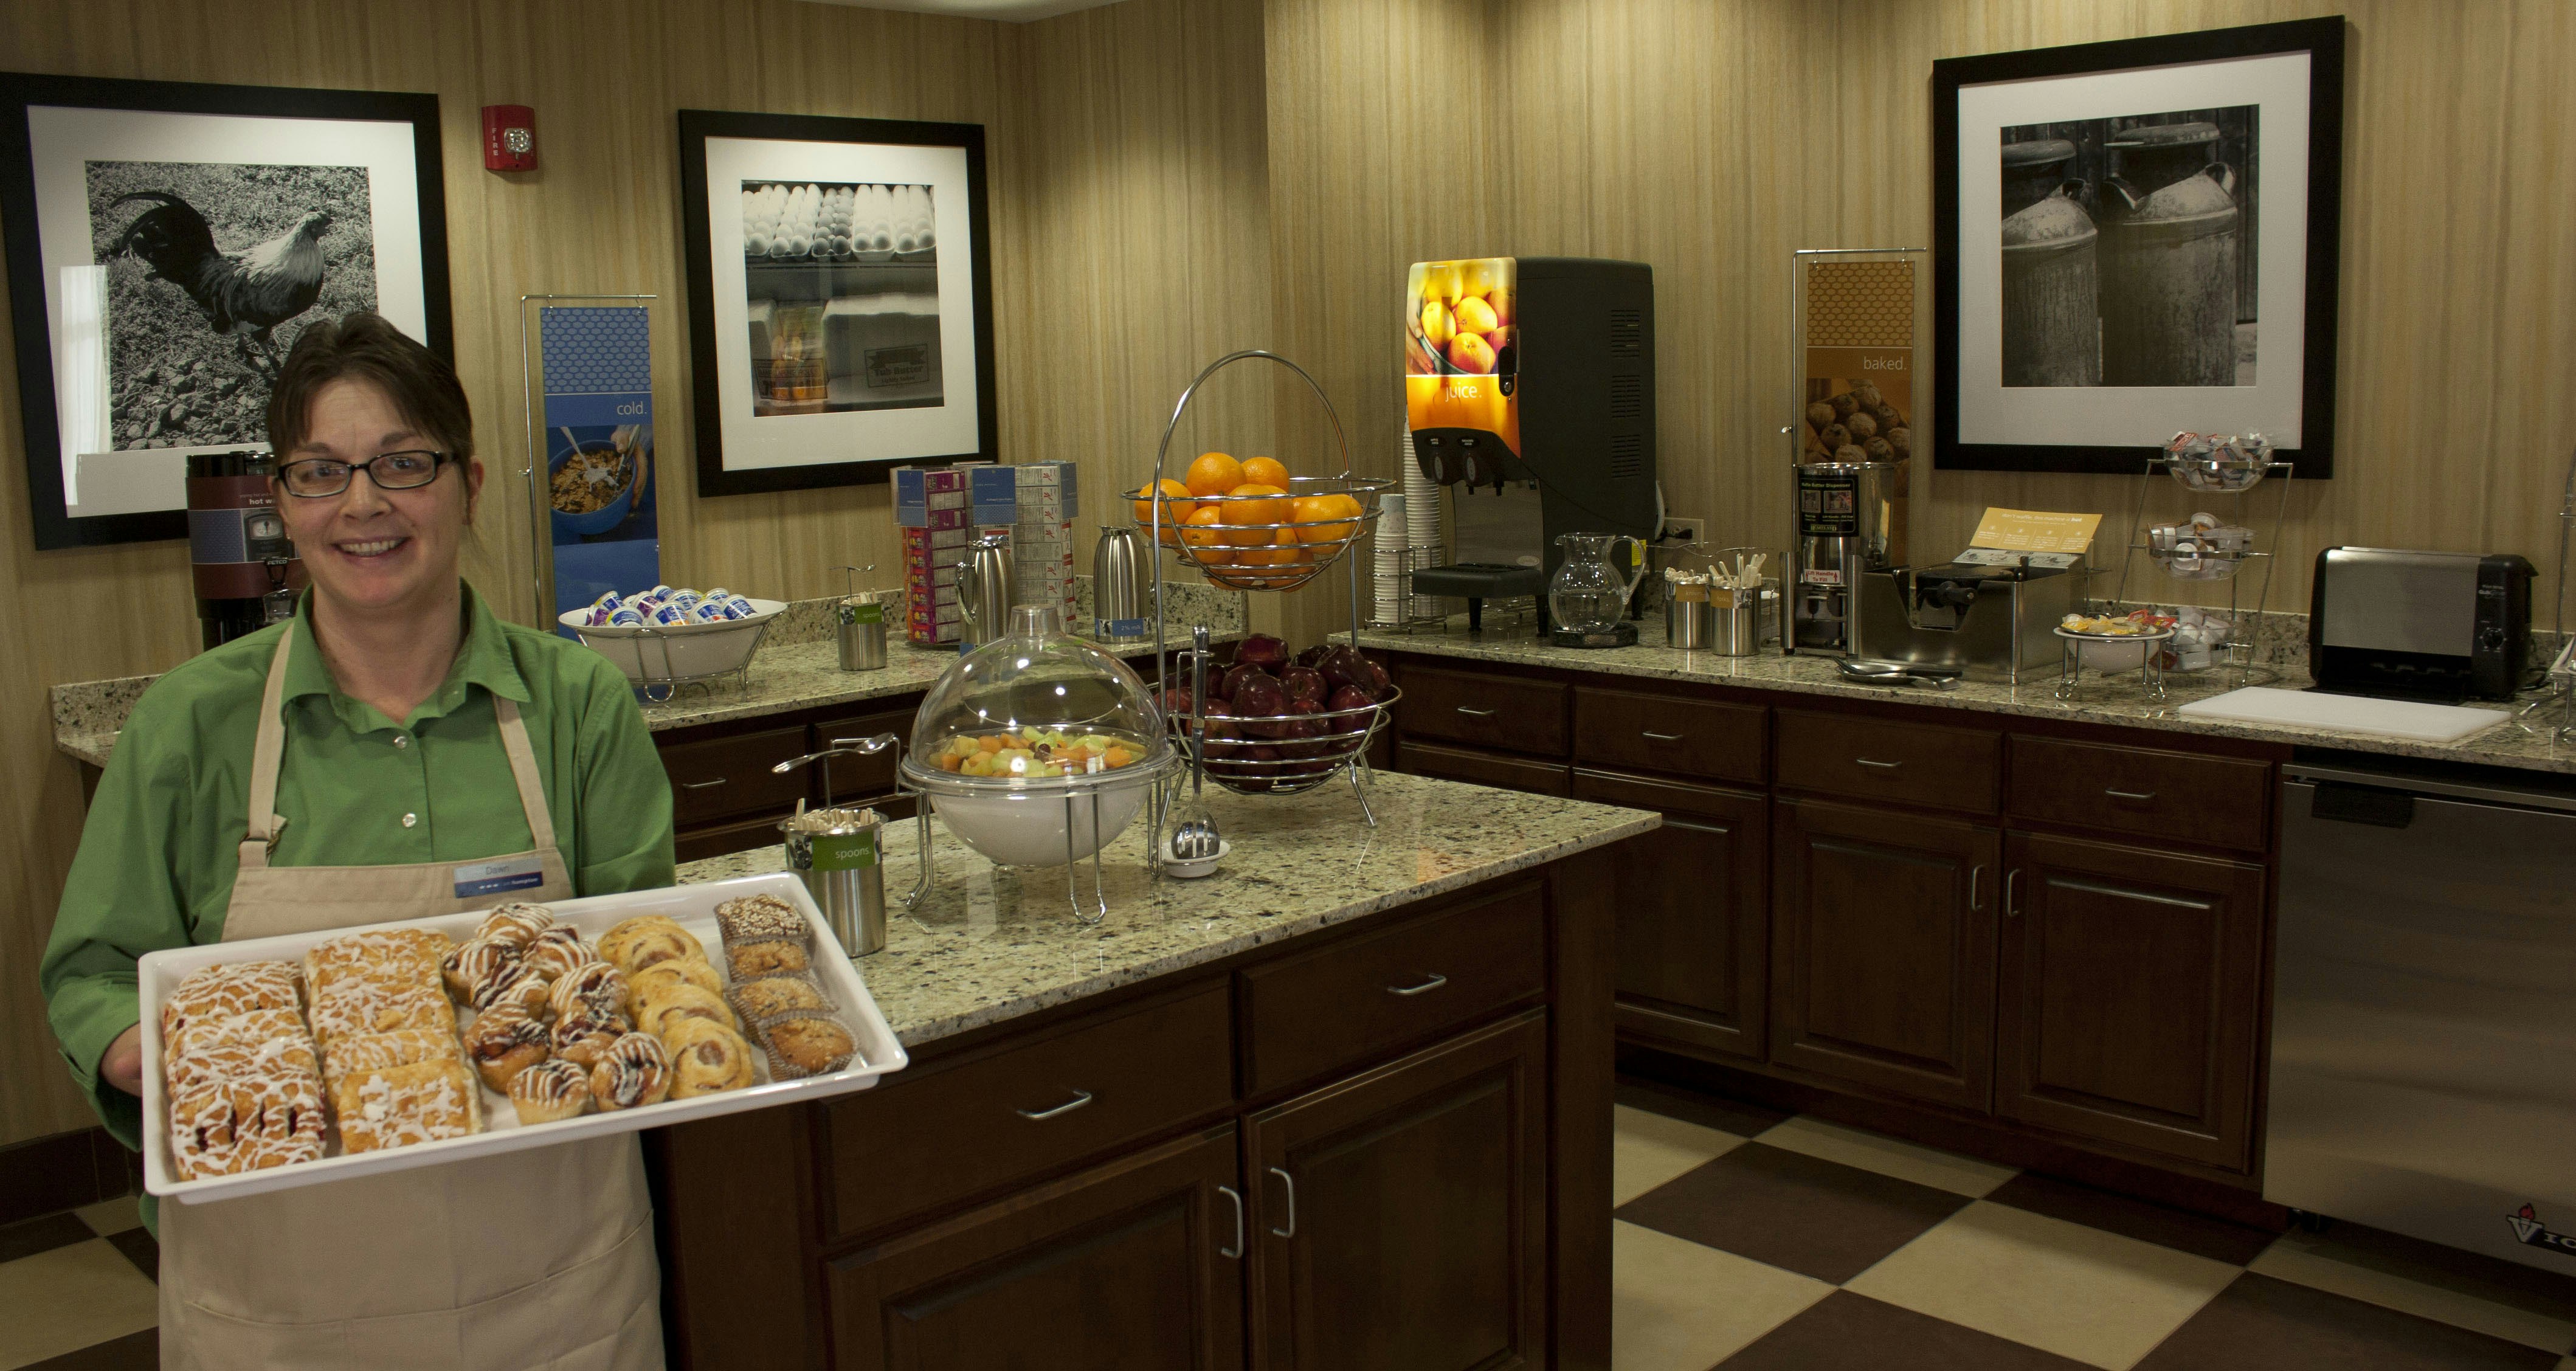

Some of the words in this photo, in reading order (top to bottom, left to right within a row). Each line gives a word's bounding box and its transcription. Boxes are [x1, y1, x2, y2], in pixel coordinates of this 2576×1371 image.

[1863, 356, 1907, 370] baked.
[1445, 381, 1482, 402] juice.
[616, 401, 647, 415] cold.
[486, 865, 509, 875] Dawn
